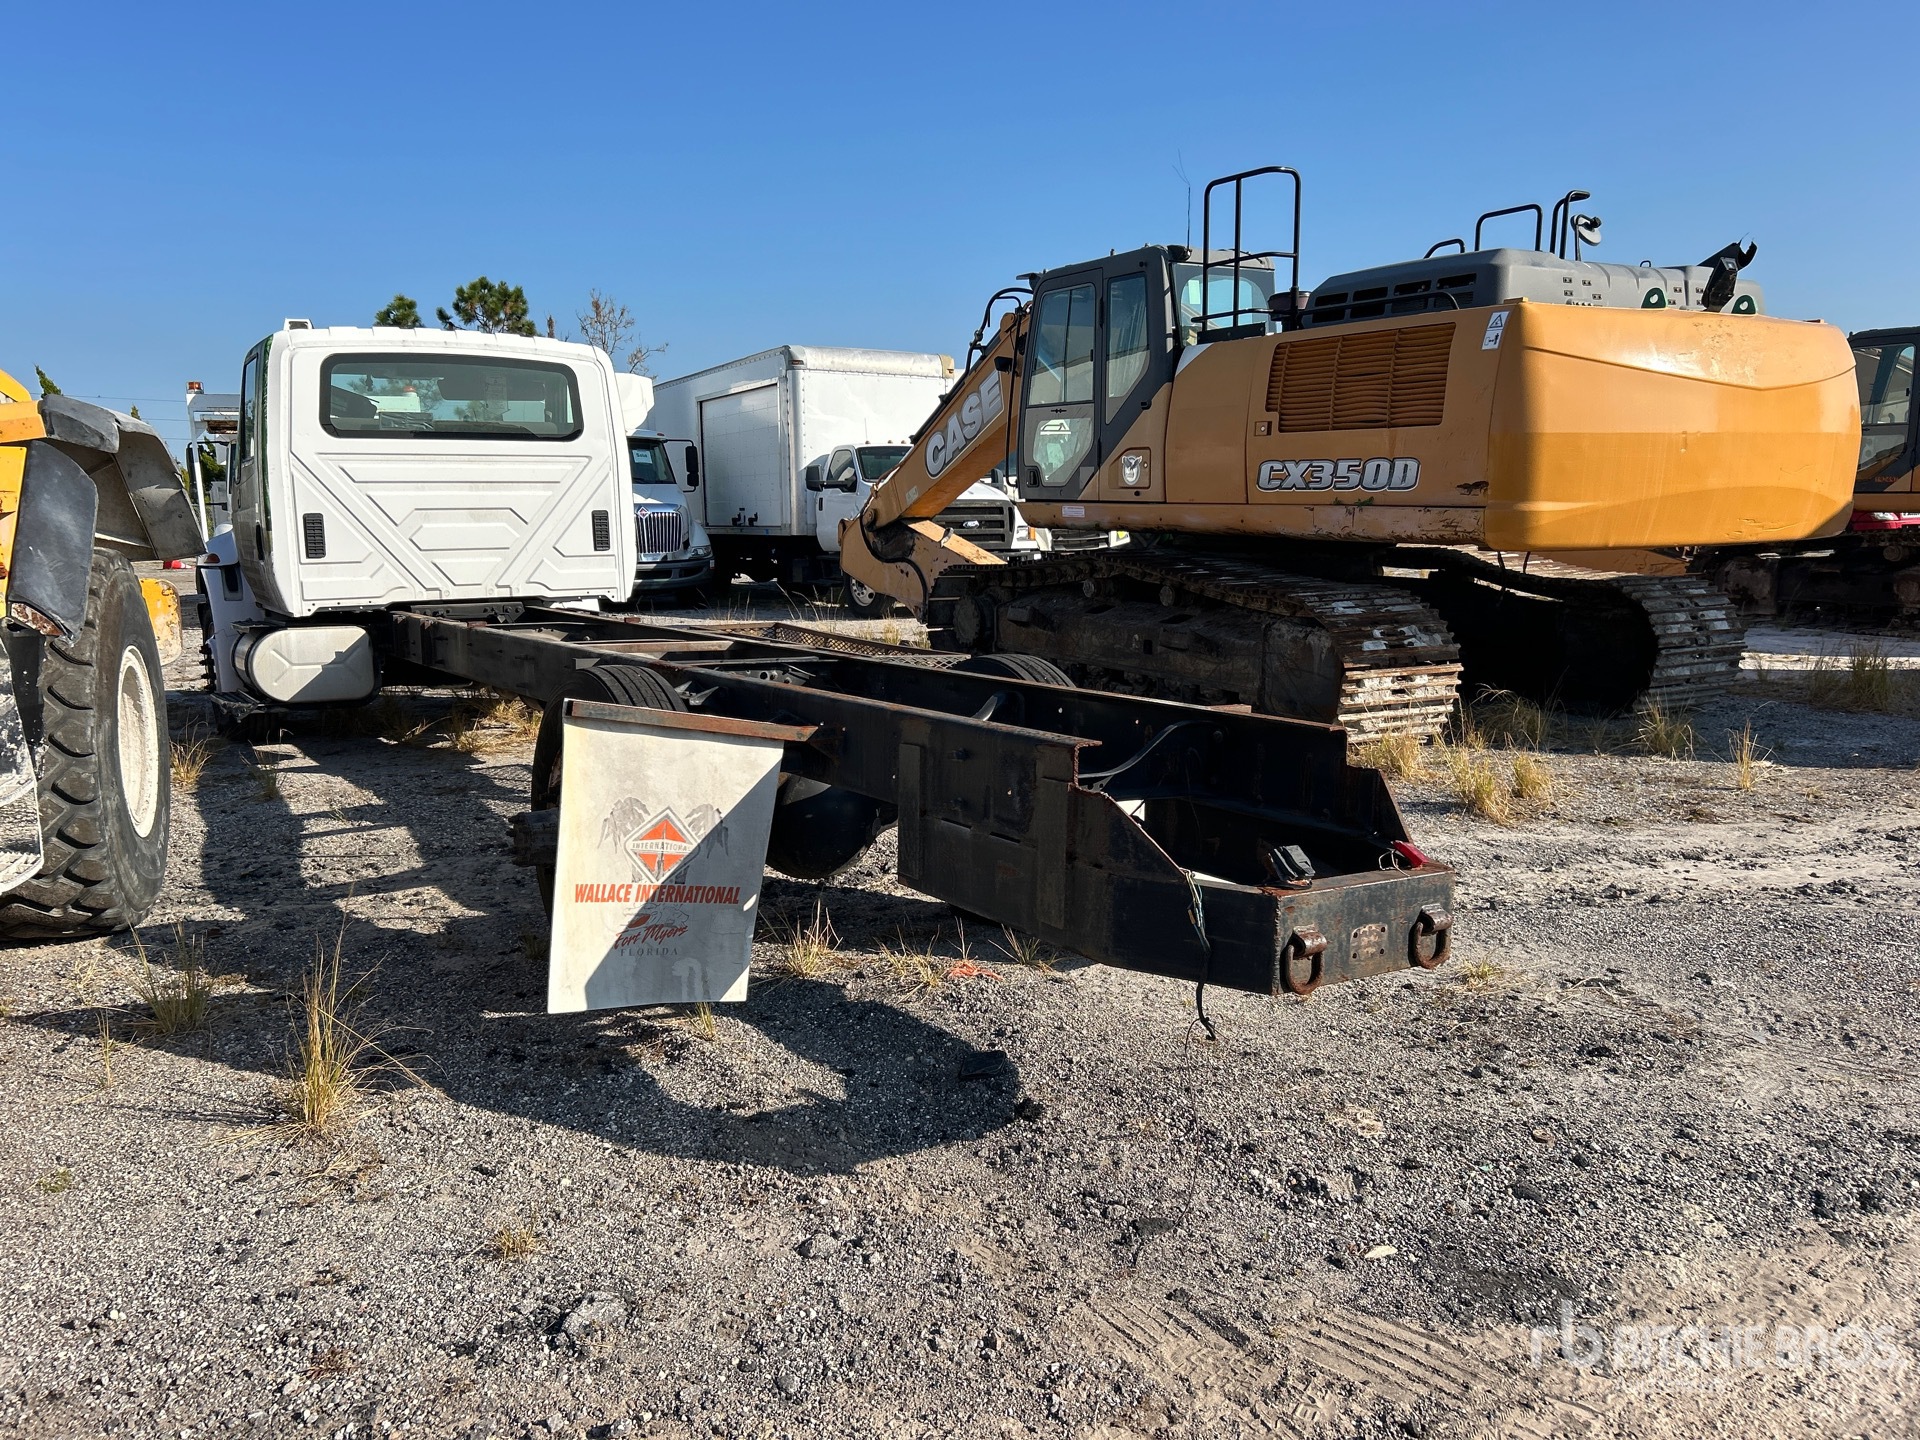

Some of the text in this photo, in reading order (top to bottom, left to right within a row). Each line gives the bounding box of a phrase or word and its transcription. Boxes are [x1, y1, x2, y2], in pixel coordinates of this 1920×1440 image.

[925, 369, 1002, 477] CASE
[1257, 457, 1421, 492] CX350D
[632, 841, 691, 851] INTERNATIONAL
[575, 883, 740, 904] WALLACE INTERNATIONAL
[614, 923, 689, 950] Fort Myers
[620, 947, 678, 957] FLORIDA
